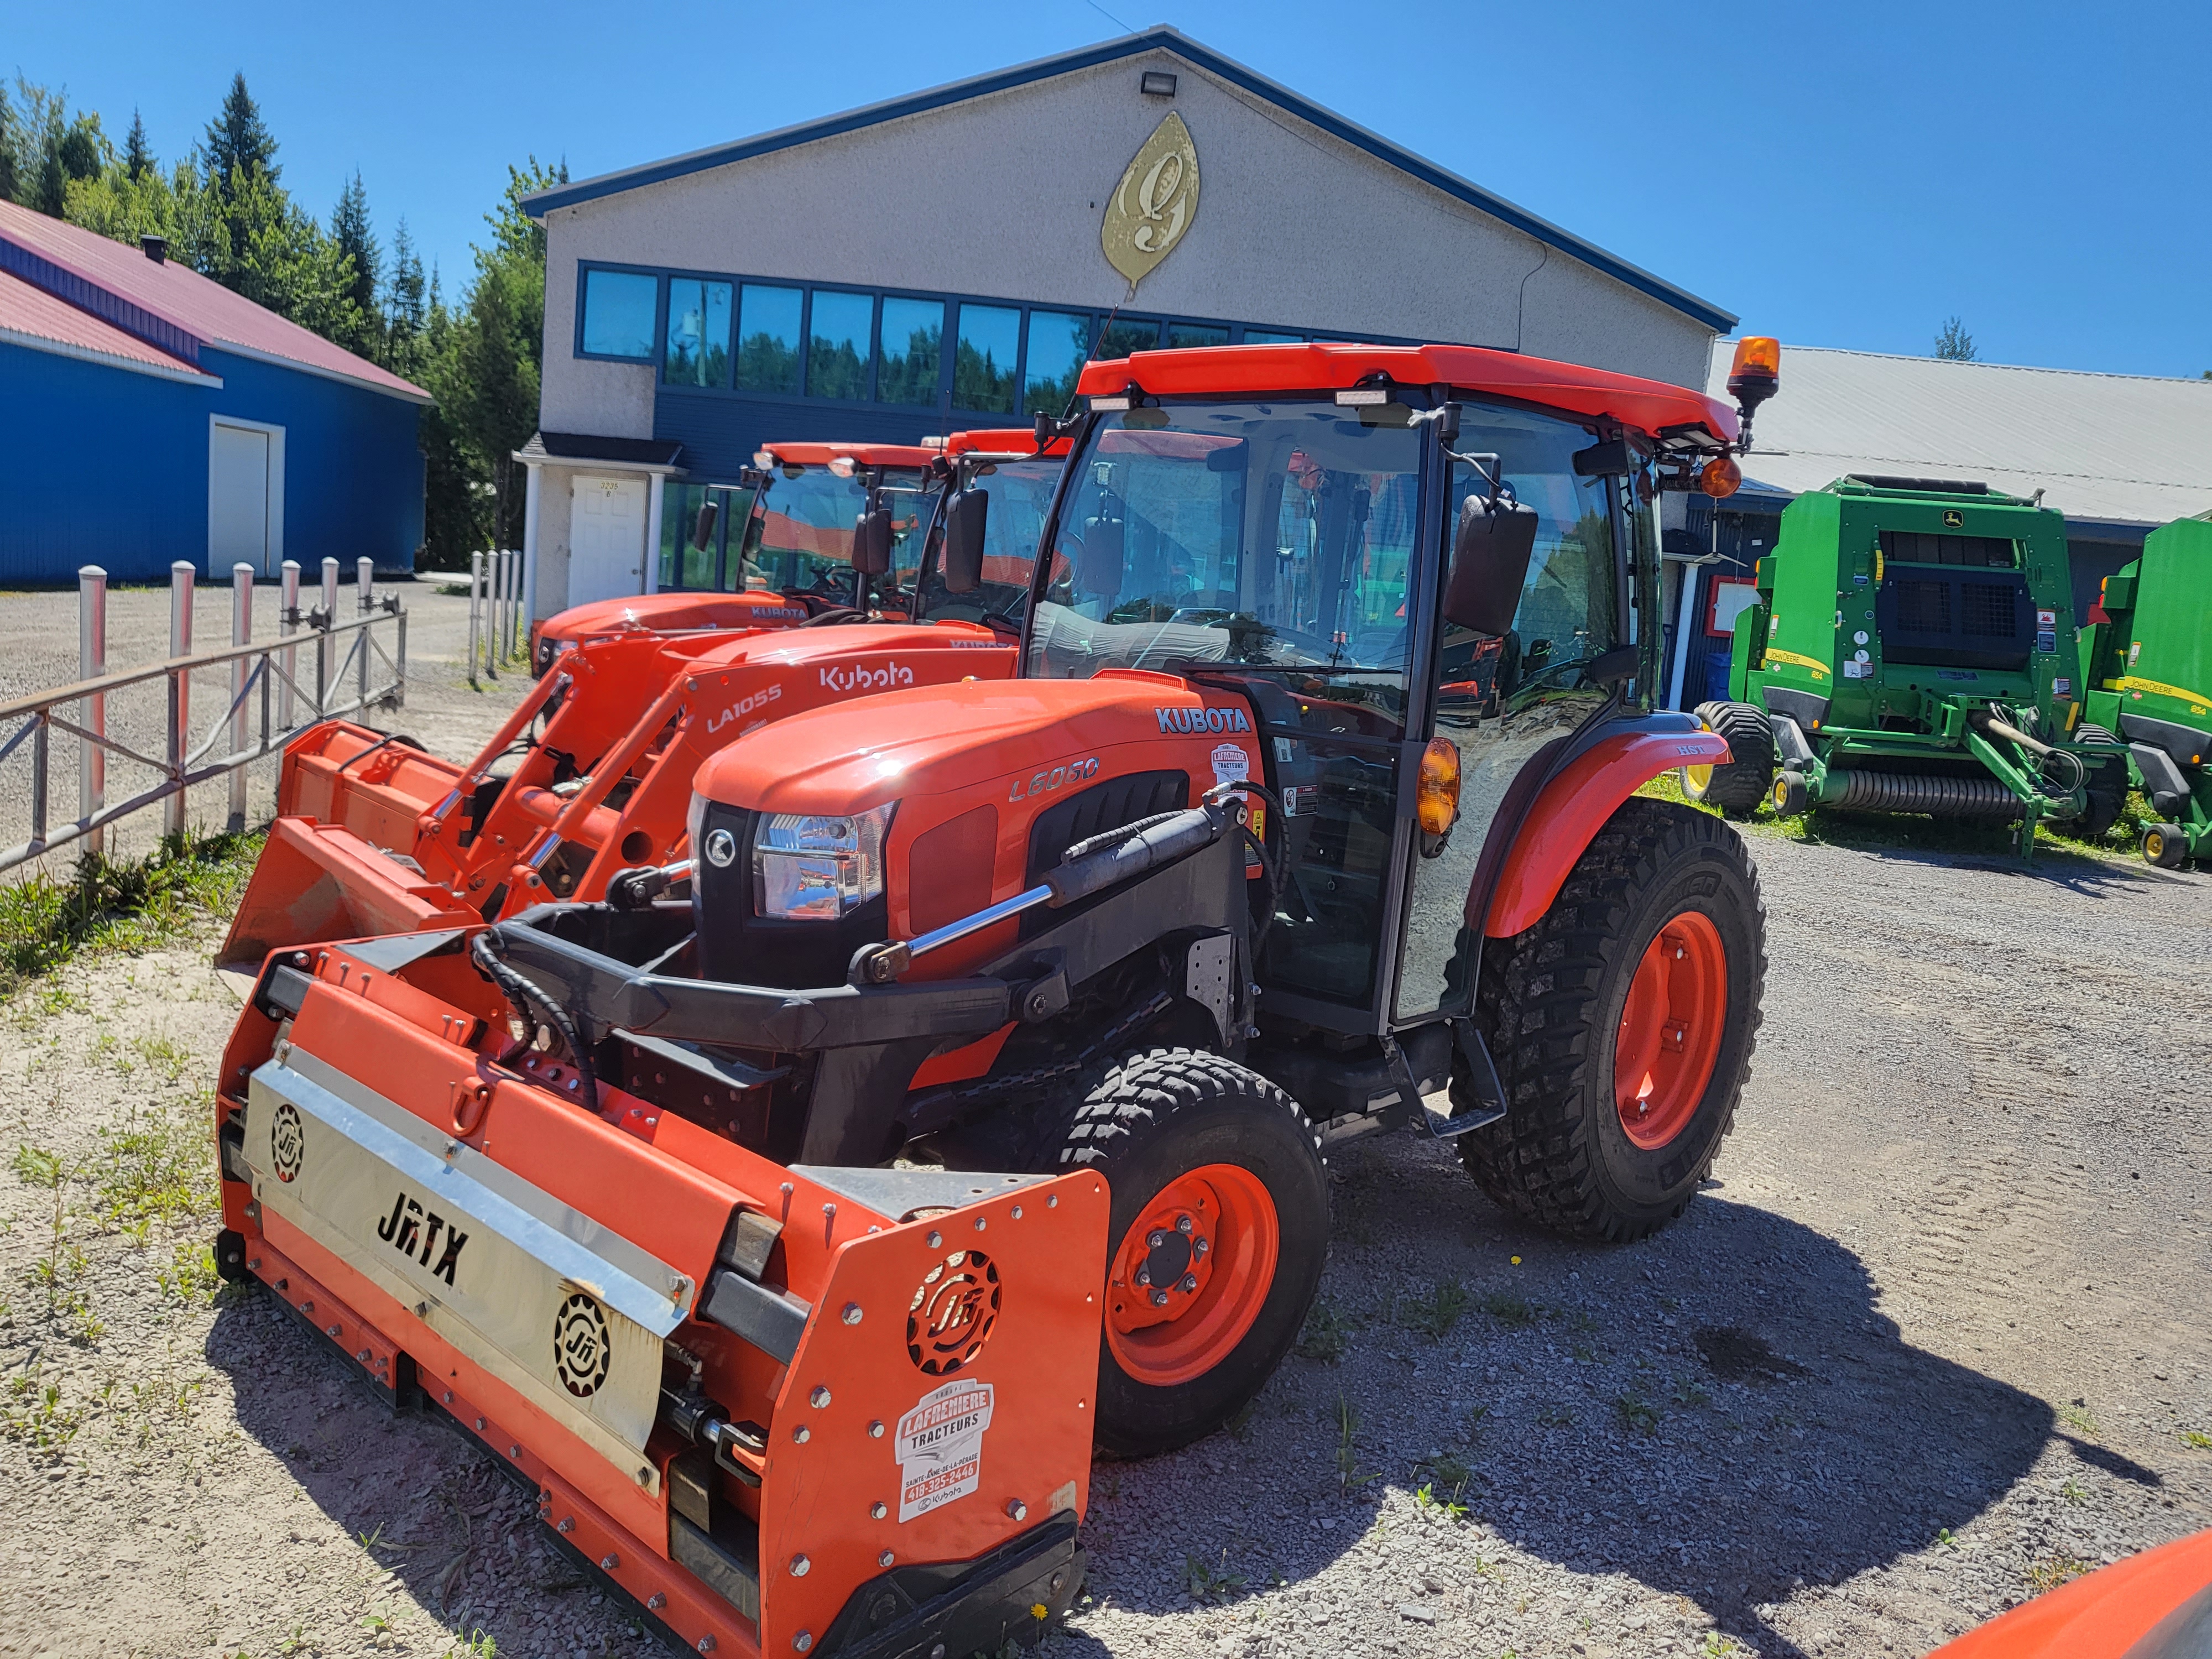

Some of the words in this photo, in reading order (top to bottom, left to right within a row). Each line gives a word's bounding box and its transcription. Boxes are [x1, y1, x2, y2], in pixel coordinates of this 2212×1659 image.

[599, 482, 618, 490] 3235
[751, 607, 807, 619] KUBOTA
[1770, 651, 1782, 660] JOHN
[1783, 653, 1799, 663] DEERE
[820, 661, 914, 691] Kubota
[1812, 670, 1823, 680] 854
[2130, 679, 2149, 690] JOHN
[2150, 682, 2173, 695] DEERE
[707, 684, 782, 733] LA1055
[2190, 705, 2206, 716] 854
[1155, 708, 1251, 734] KUBOTA
[1676, 745, 1705, 756] HST
[1008, 757, 1099, 802] L6060
[378, 1192, 469, 1287] JRTX
[936, 1385, 962, 1400] GROUPE
[905, 1391, 987, 1437] LAFRENIERE
[912, 1413, 978, 1449] TRACTEURS
[906, 1452, 978, 1488] SAINTE-ANNE-DE-LA-PÉRADE
[908, 1464, 974, 1500] 418-325-2446
[933, 1486, 963, 1503] Kubota
